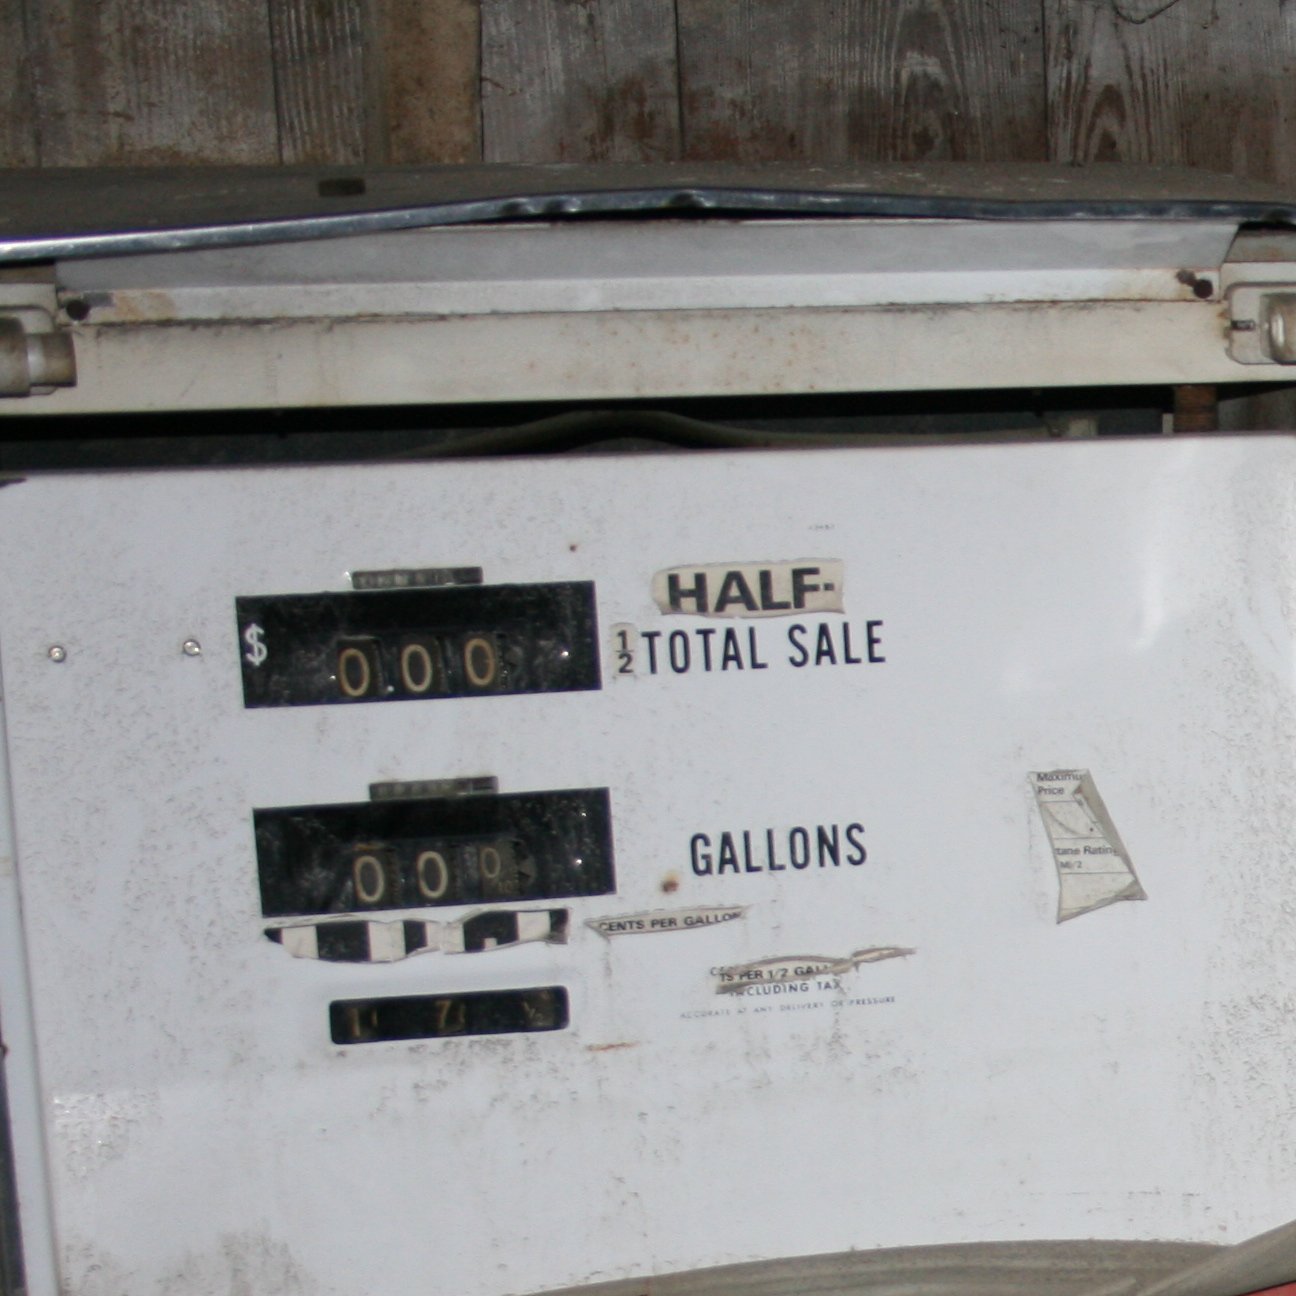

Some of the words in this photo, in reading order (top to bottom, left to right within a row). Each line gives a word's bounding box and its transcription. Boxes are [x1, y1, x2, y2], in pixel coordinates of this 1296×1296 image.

[243, 622, 268, 668] $
[641, 626, 769, 676] TOTAL
[788, 619, 888, 667] SALE
[689, 823, 869, 877] GALLONS
[599, 919, 645, 933] CENTS
[650, 917, 678, 930] PER
[816, 978, 842, 992] TAX
